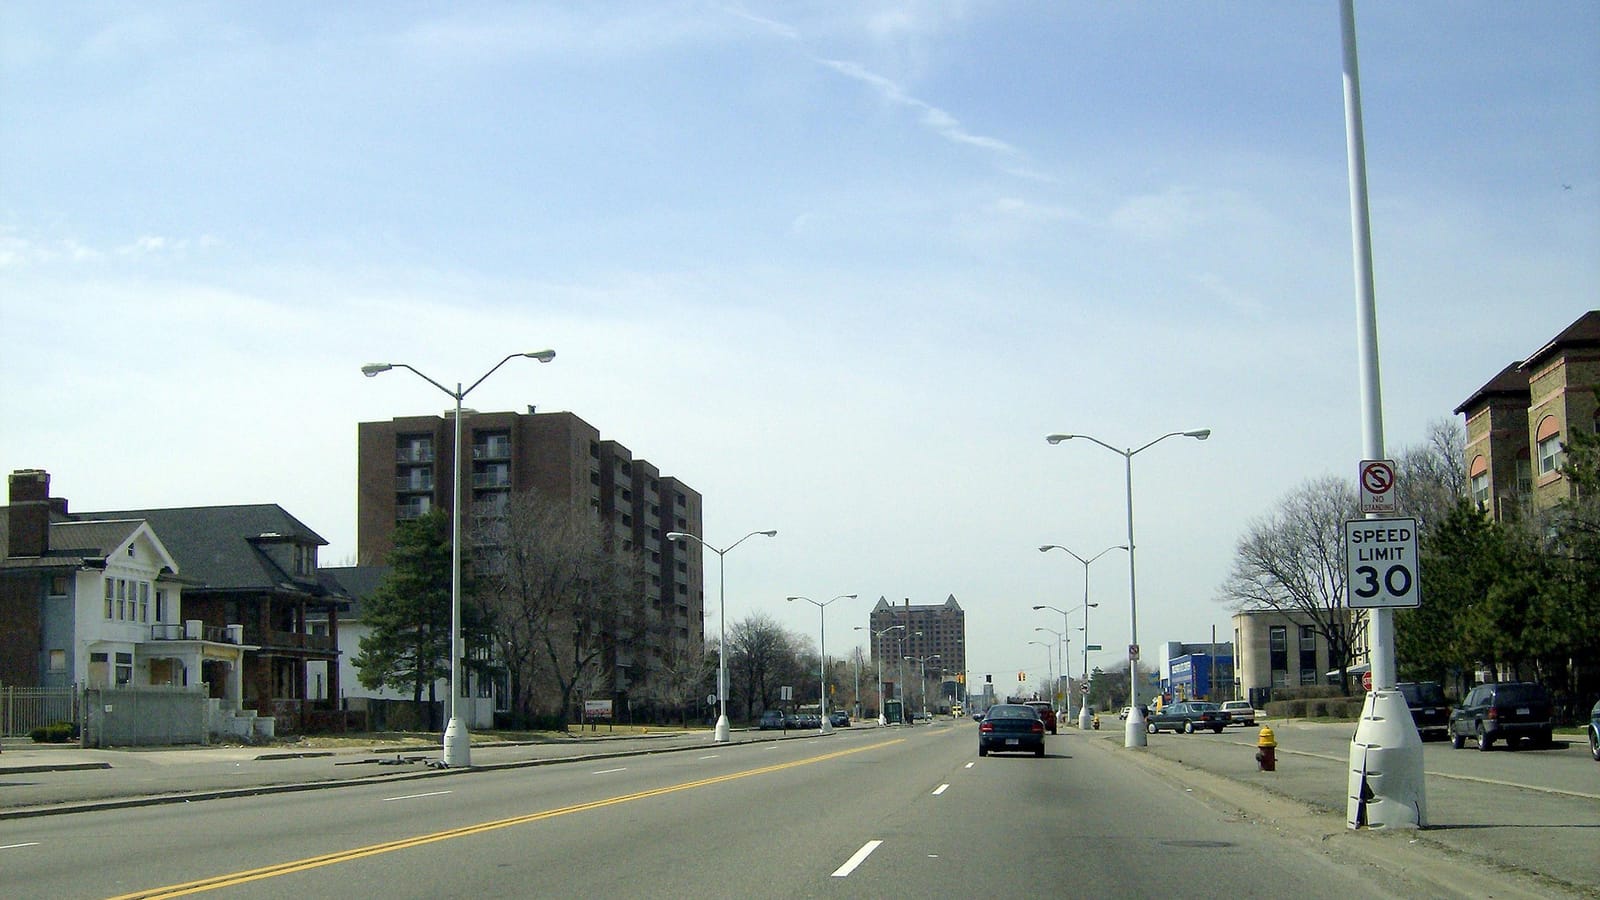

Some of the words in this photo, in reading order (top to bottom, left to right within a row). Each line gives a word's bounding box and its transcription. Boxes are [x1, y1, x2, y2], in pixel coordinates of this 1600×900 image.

[1372, 495, 1385, 503] NO
[1363, 503, 1394, 512] STANDING
[1352, 529, 1411, 543] SPEED
[1359, 547, 1405, 561] LIMIT
[1354, 565, 1413, 598] 30
